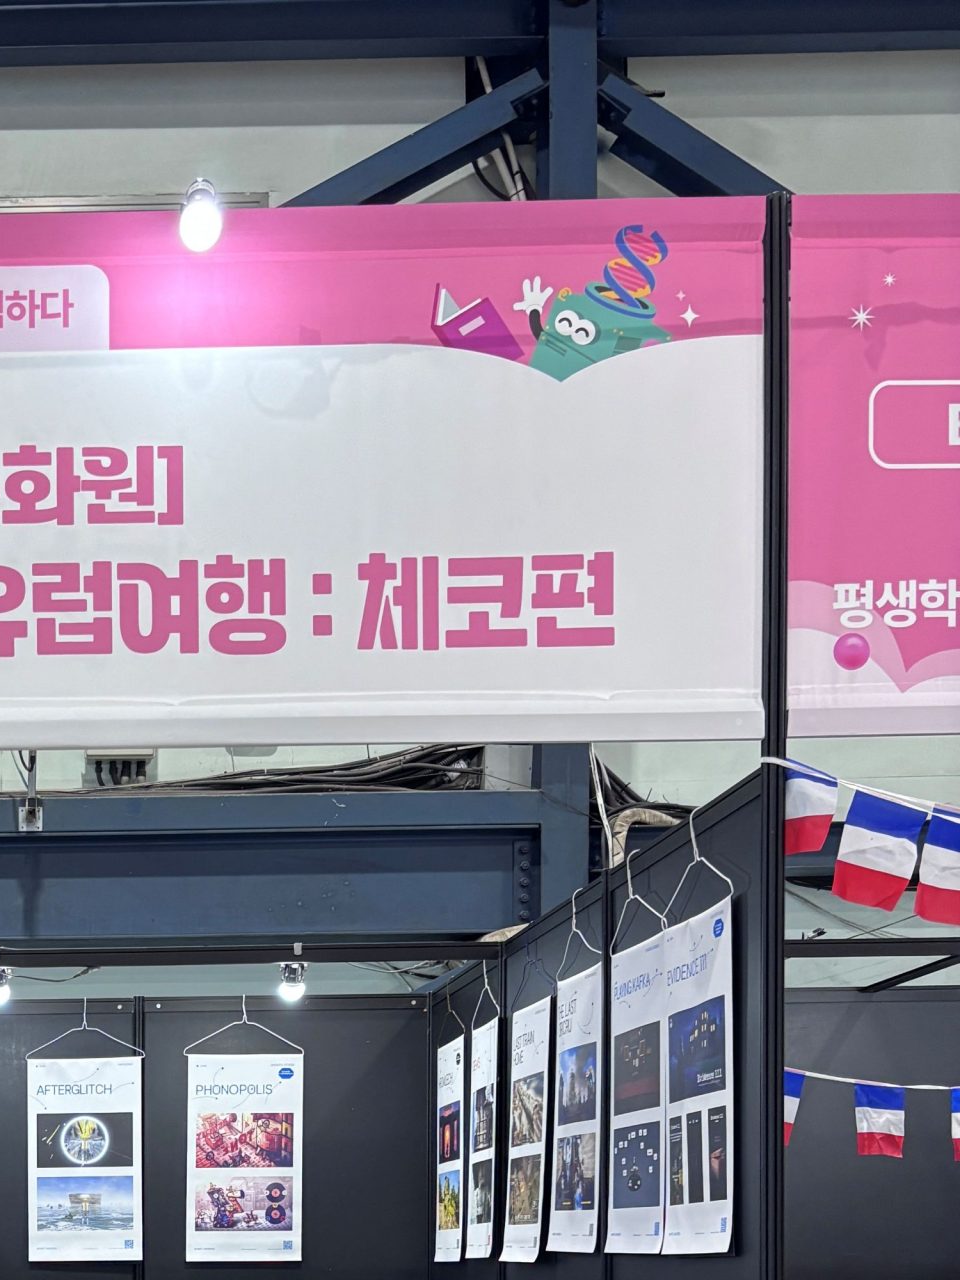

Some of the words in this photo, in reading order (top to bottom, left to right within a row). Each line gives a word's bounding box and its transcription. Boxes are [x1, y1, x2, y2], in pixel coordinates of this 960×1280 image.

[357, 550, 617, 653] 체코편
[36, 1084, 113, 1095] AFTERGLITCH
[195, 1084, 273, 1095] PHONOPOLIS
